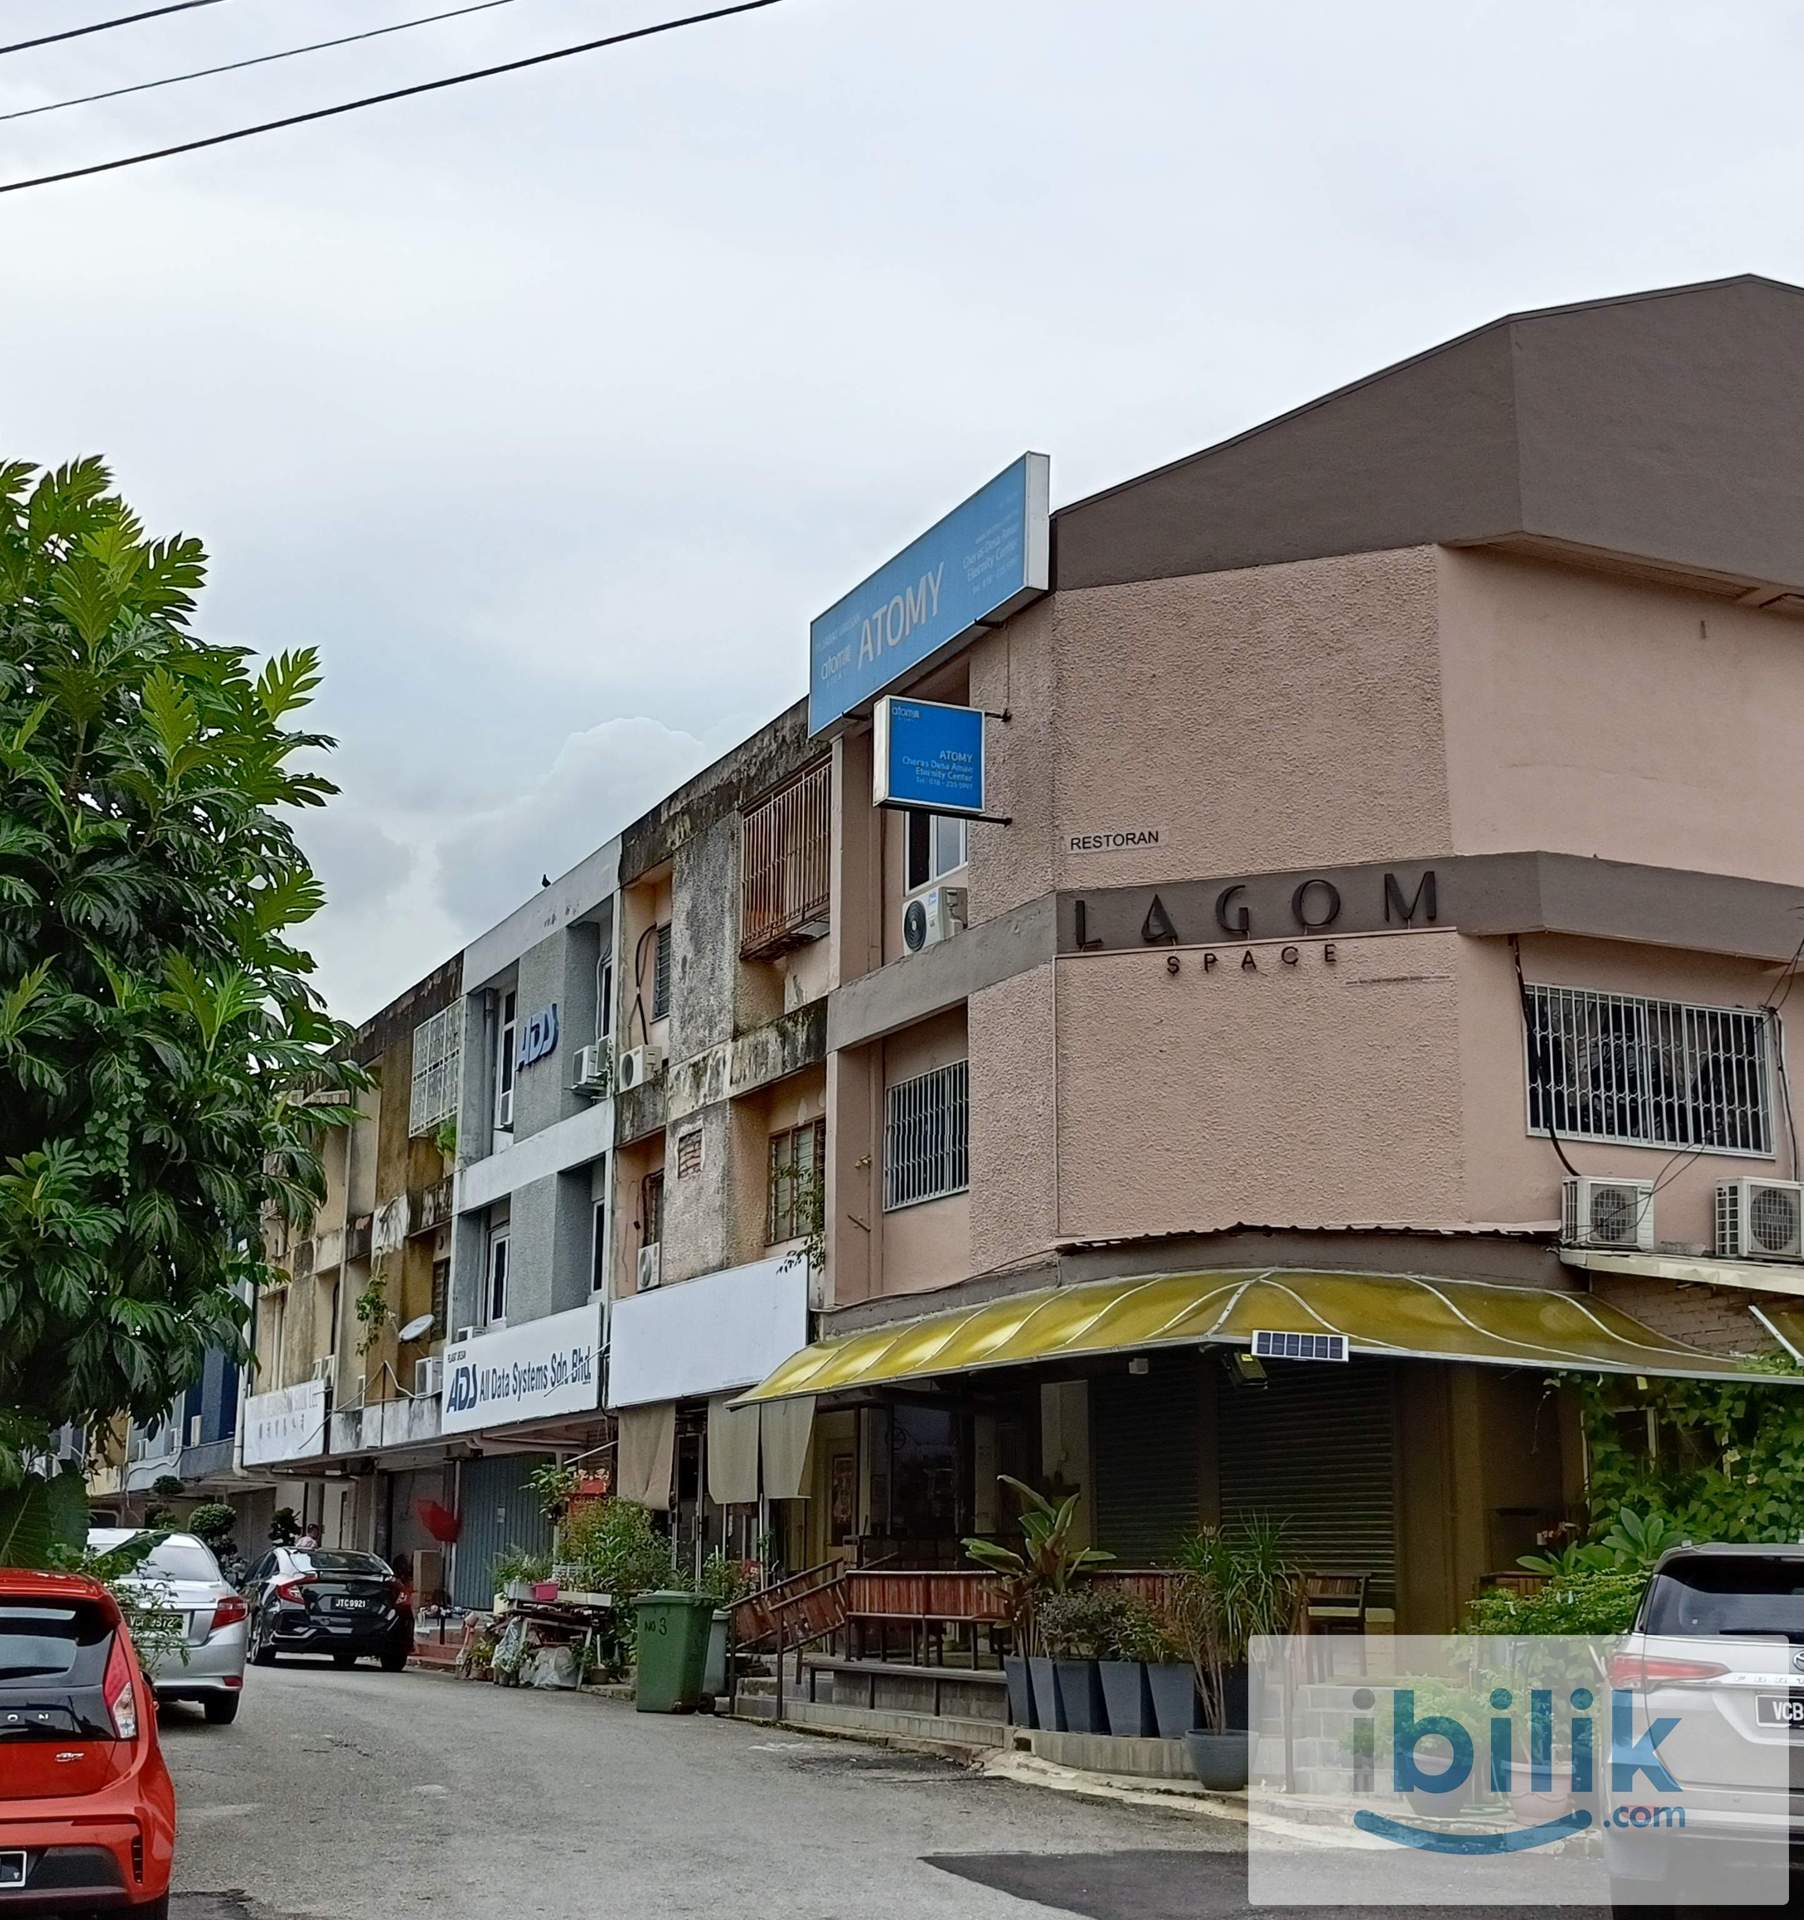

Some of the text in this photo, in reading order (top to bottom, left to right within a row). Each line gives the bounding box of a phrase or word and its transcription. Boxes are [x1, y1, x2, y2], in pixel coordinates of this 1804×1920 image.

[858, 561, 944, 671] ATOMY
[939, 750, 974, 763] ATOMY
[1070, 831, 1160, 851] RESTORAN
[1074, 870, 1437, 948] LAGOM
[1167, 943, 1337, 976] SPACE
[516, 1003, 559, 1072] ADS
[446, 1363, 477, 1413] ADS
[480, 1370, 490, 1402] All
[491, 1367, 509, 1400] Data
[512, 1361, 548, 1401] Systems
[550, 1352, 569, 1387] Sdn
[335, 1598, 349, 1607] JTC
[659, 1617, 668, 1636] 3
[1772, 1701, 1804, 1721] VCB
